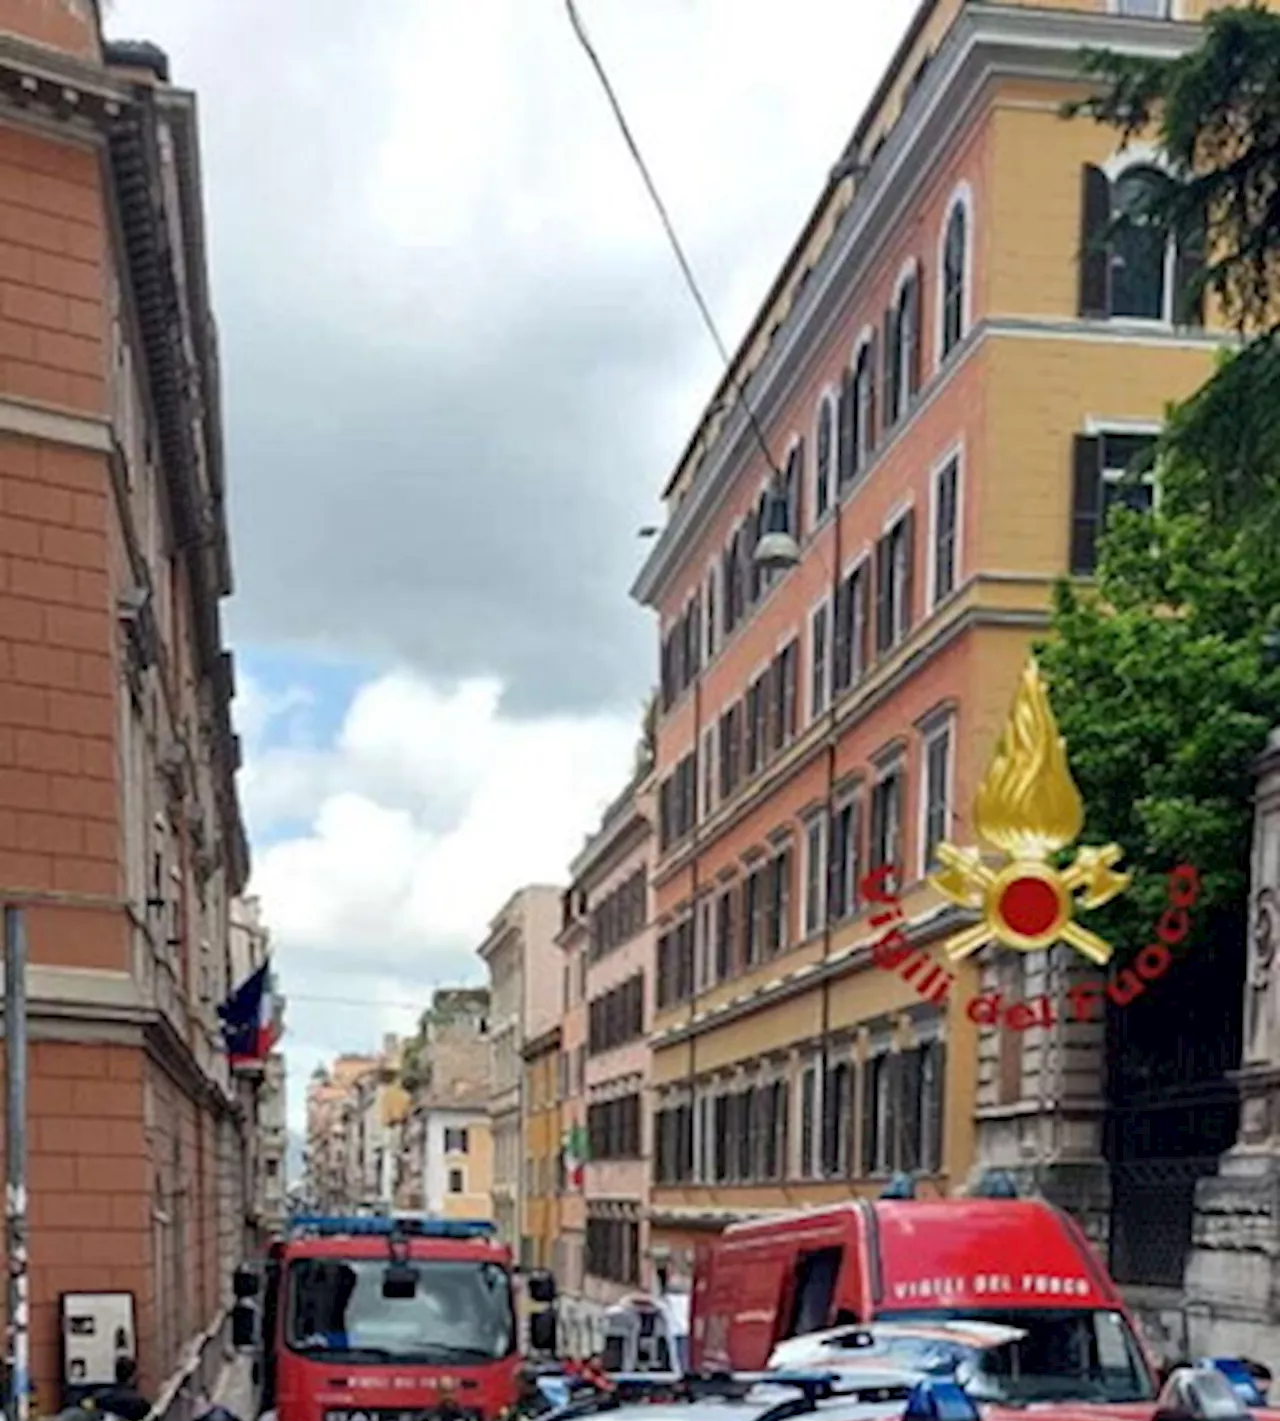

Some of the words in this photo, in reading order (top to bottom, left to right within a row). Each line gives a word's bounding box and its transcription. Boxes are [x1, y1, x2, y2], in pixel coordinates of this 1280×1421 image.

[893, 1277, 965, 1299] VIGILI
[973, 1273, 1012, 1294] DEL
[1021, 1273, 1091, 1296] FUOCO
